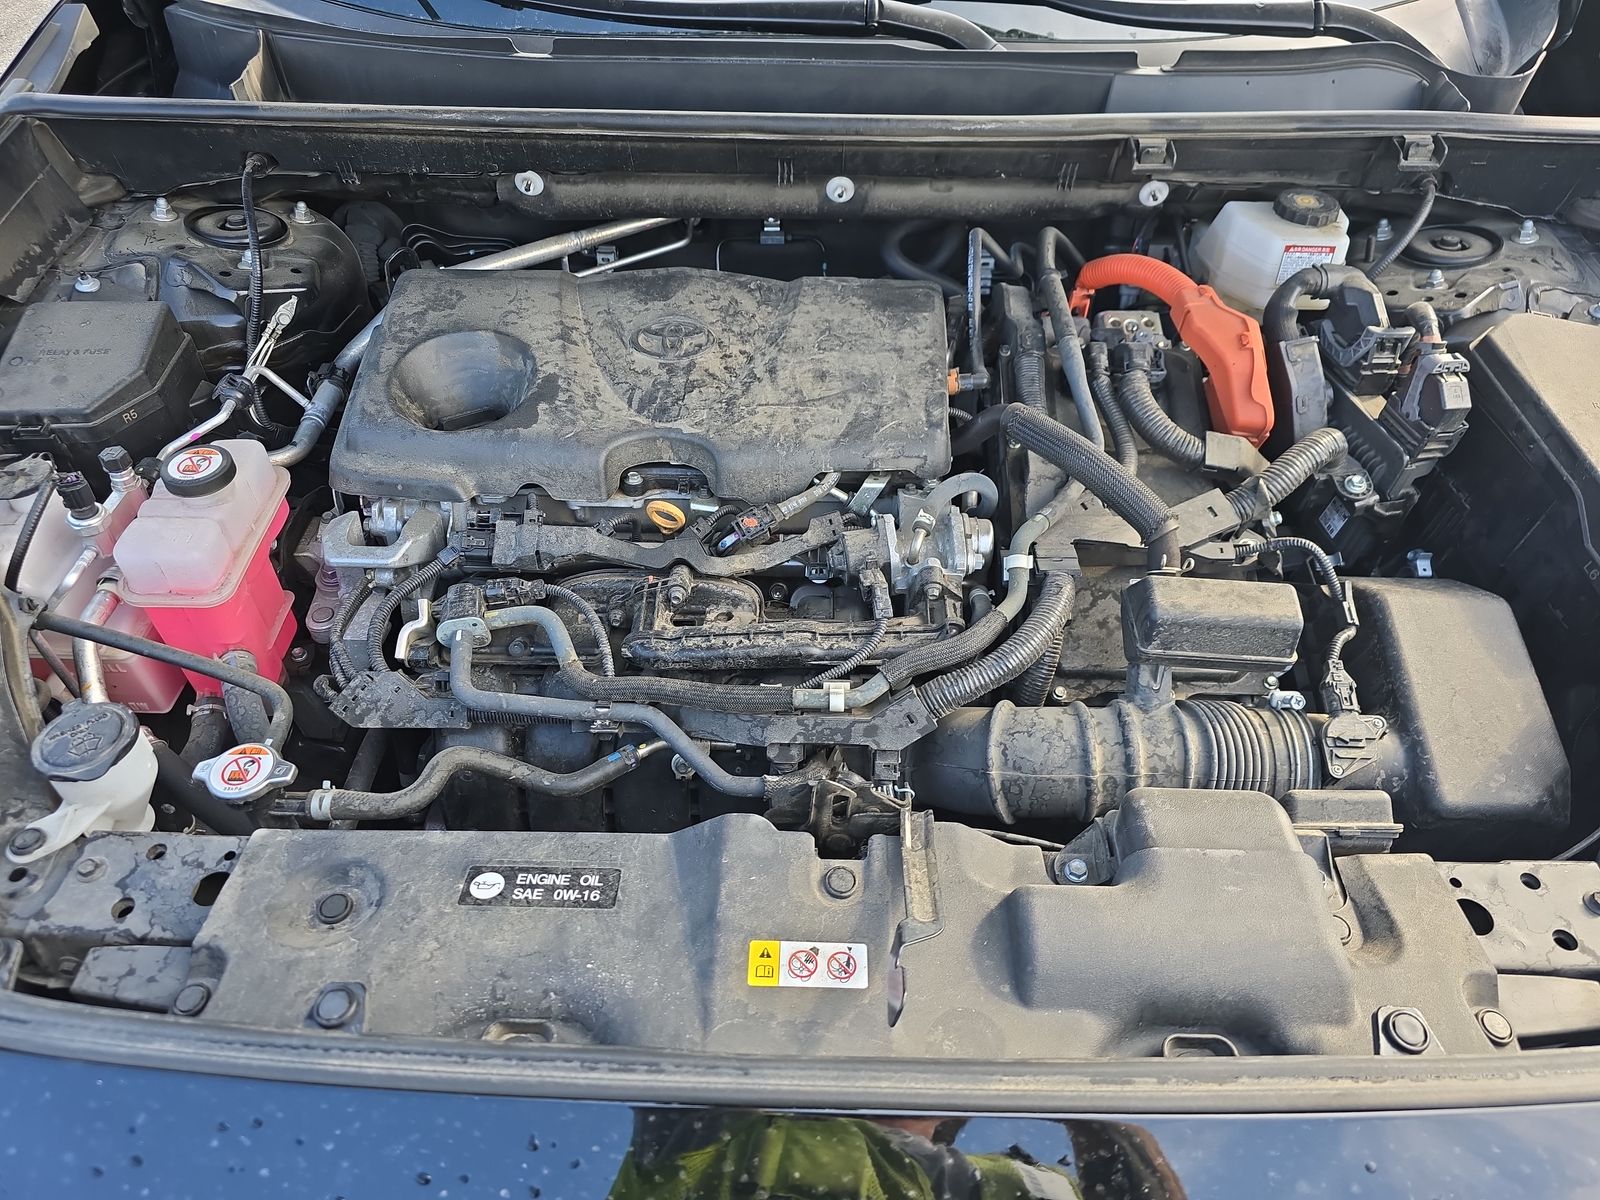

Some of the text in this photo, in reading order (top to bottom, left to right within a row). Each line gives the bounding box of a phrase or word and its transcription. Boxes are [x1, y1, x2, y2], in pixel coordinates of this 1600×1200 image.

[122, 408, 138, 424] R5
[516, 873, 604, 887] ENGINE OIL
[512, 888, 601, 902] SAE 0W-16
